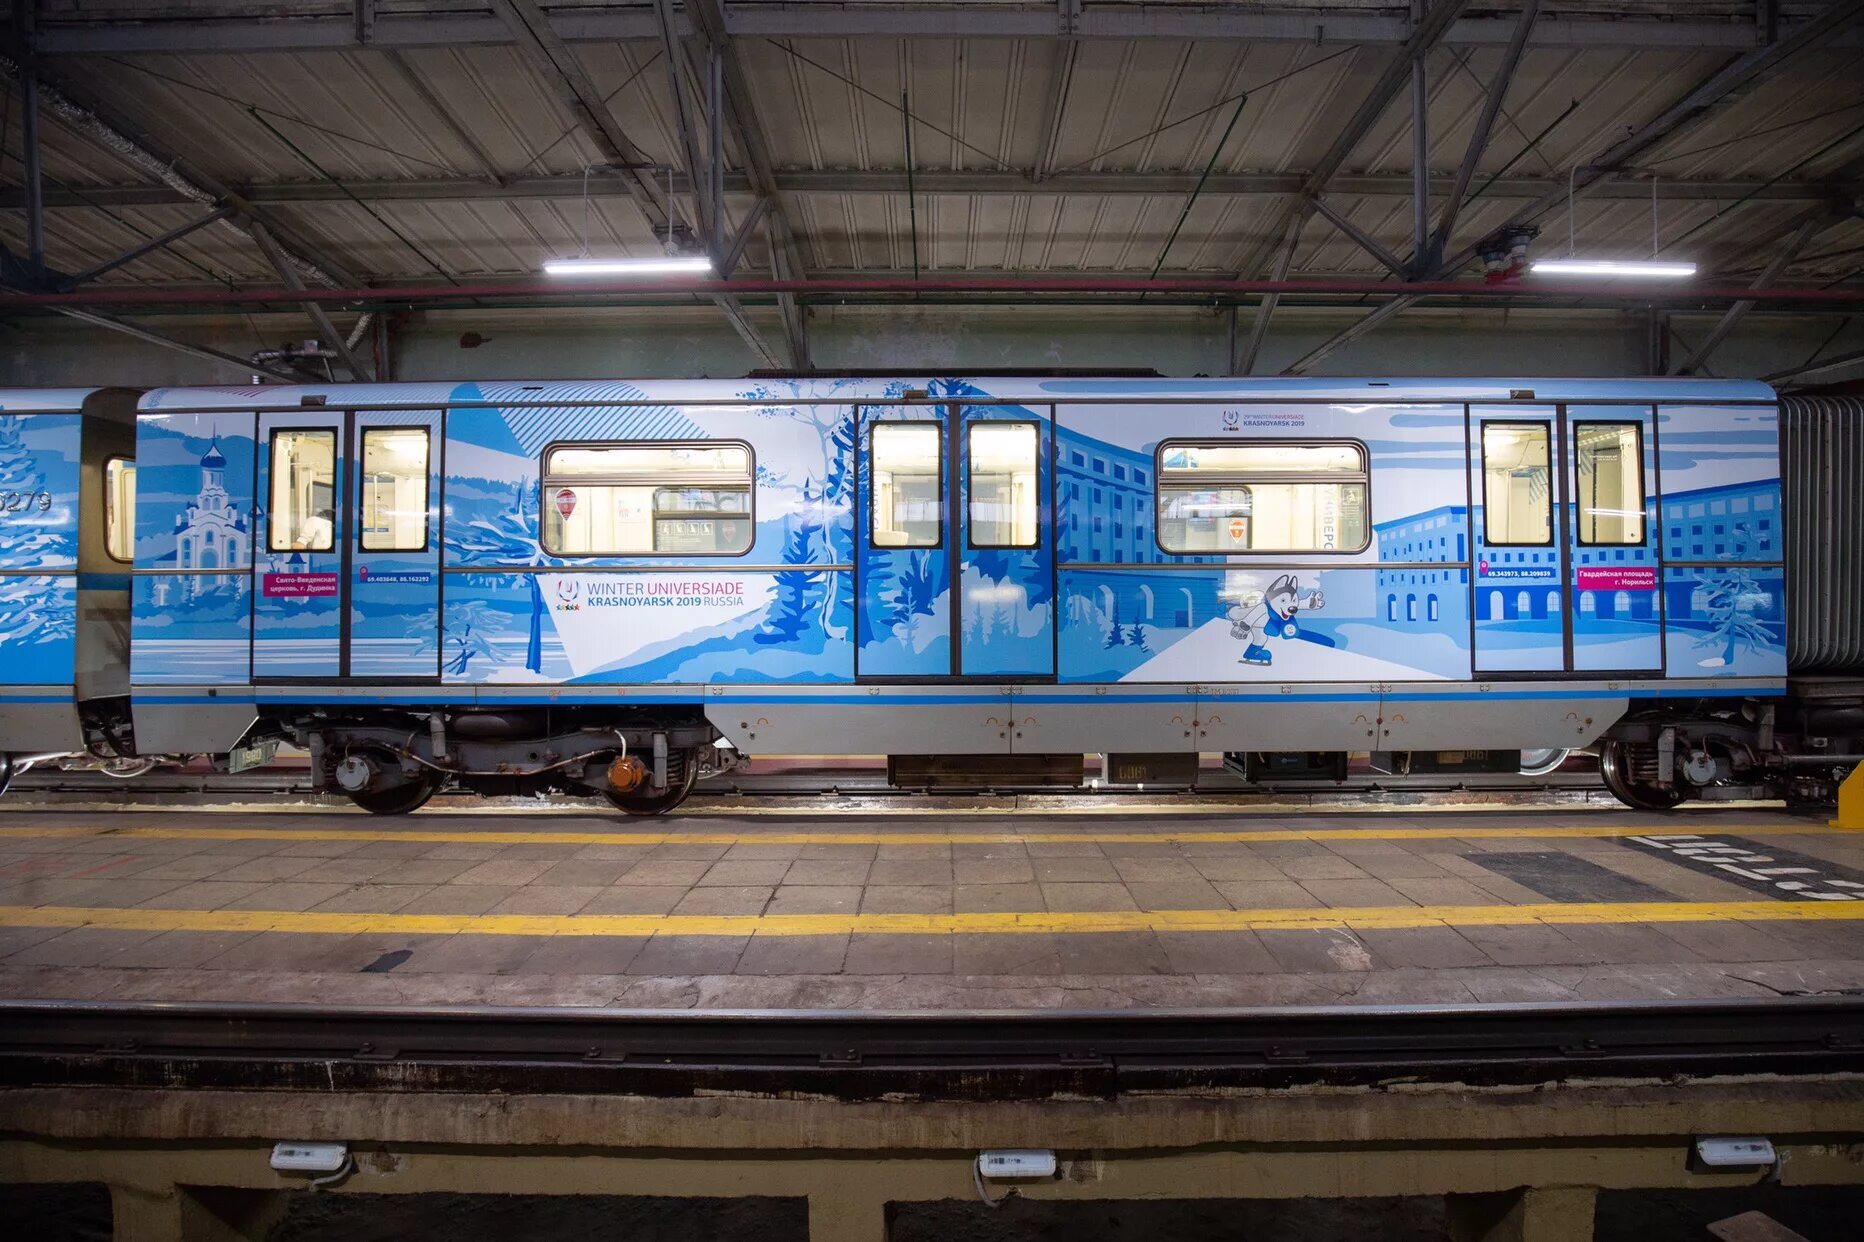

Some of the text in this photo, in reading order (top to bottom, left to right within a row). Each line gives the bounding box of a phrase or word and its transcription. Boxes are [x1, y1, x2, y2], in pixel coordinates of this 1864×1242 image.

[1579, 570, 1622, 578] Гвардейская
[275, 576, 336, 584] Свято-Введенская
[306, 585, 336, 593] Дудинка
[587, 582, 744, 595] WINTER UNIVERSIADE
[588, 596, 744, 607] KRASNOYARSK 2019 RUSSIA
